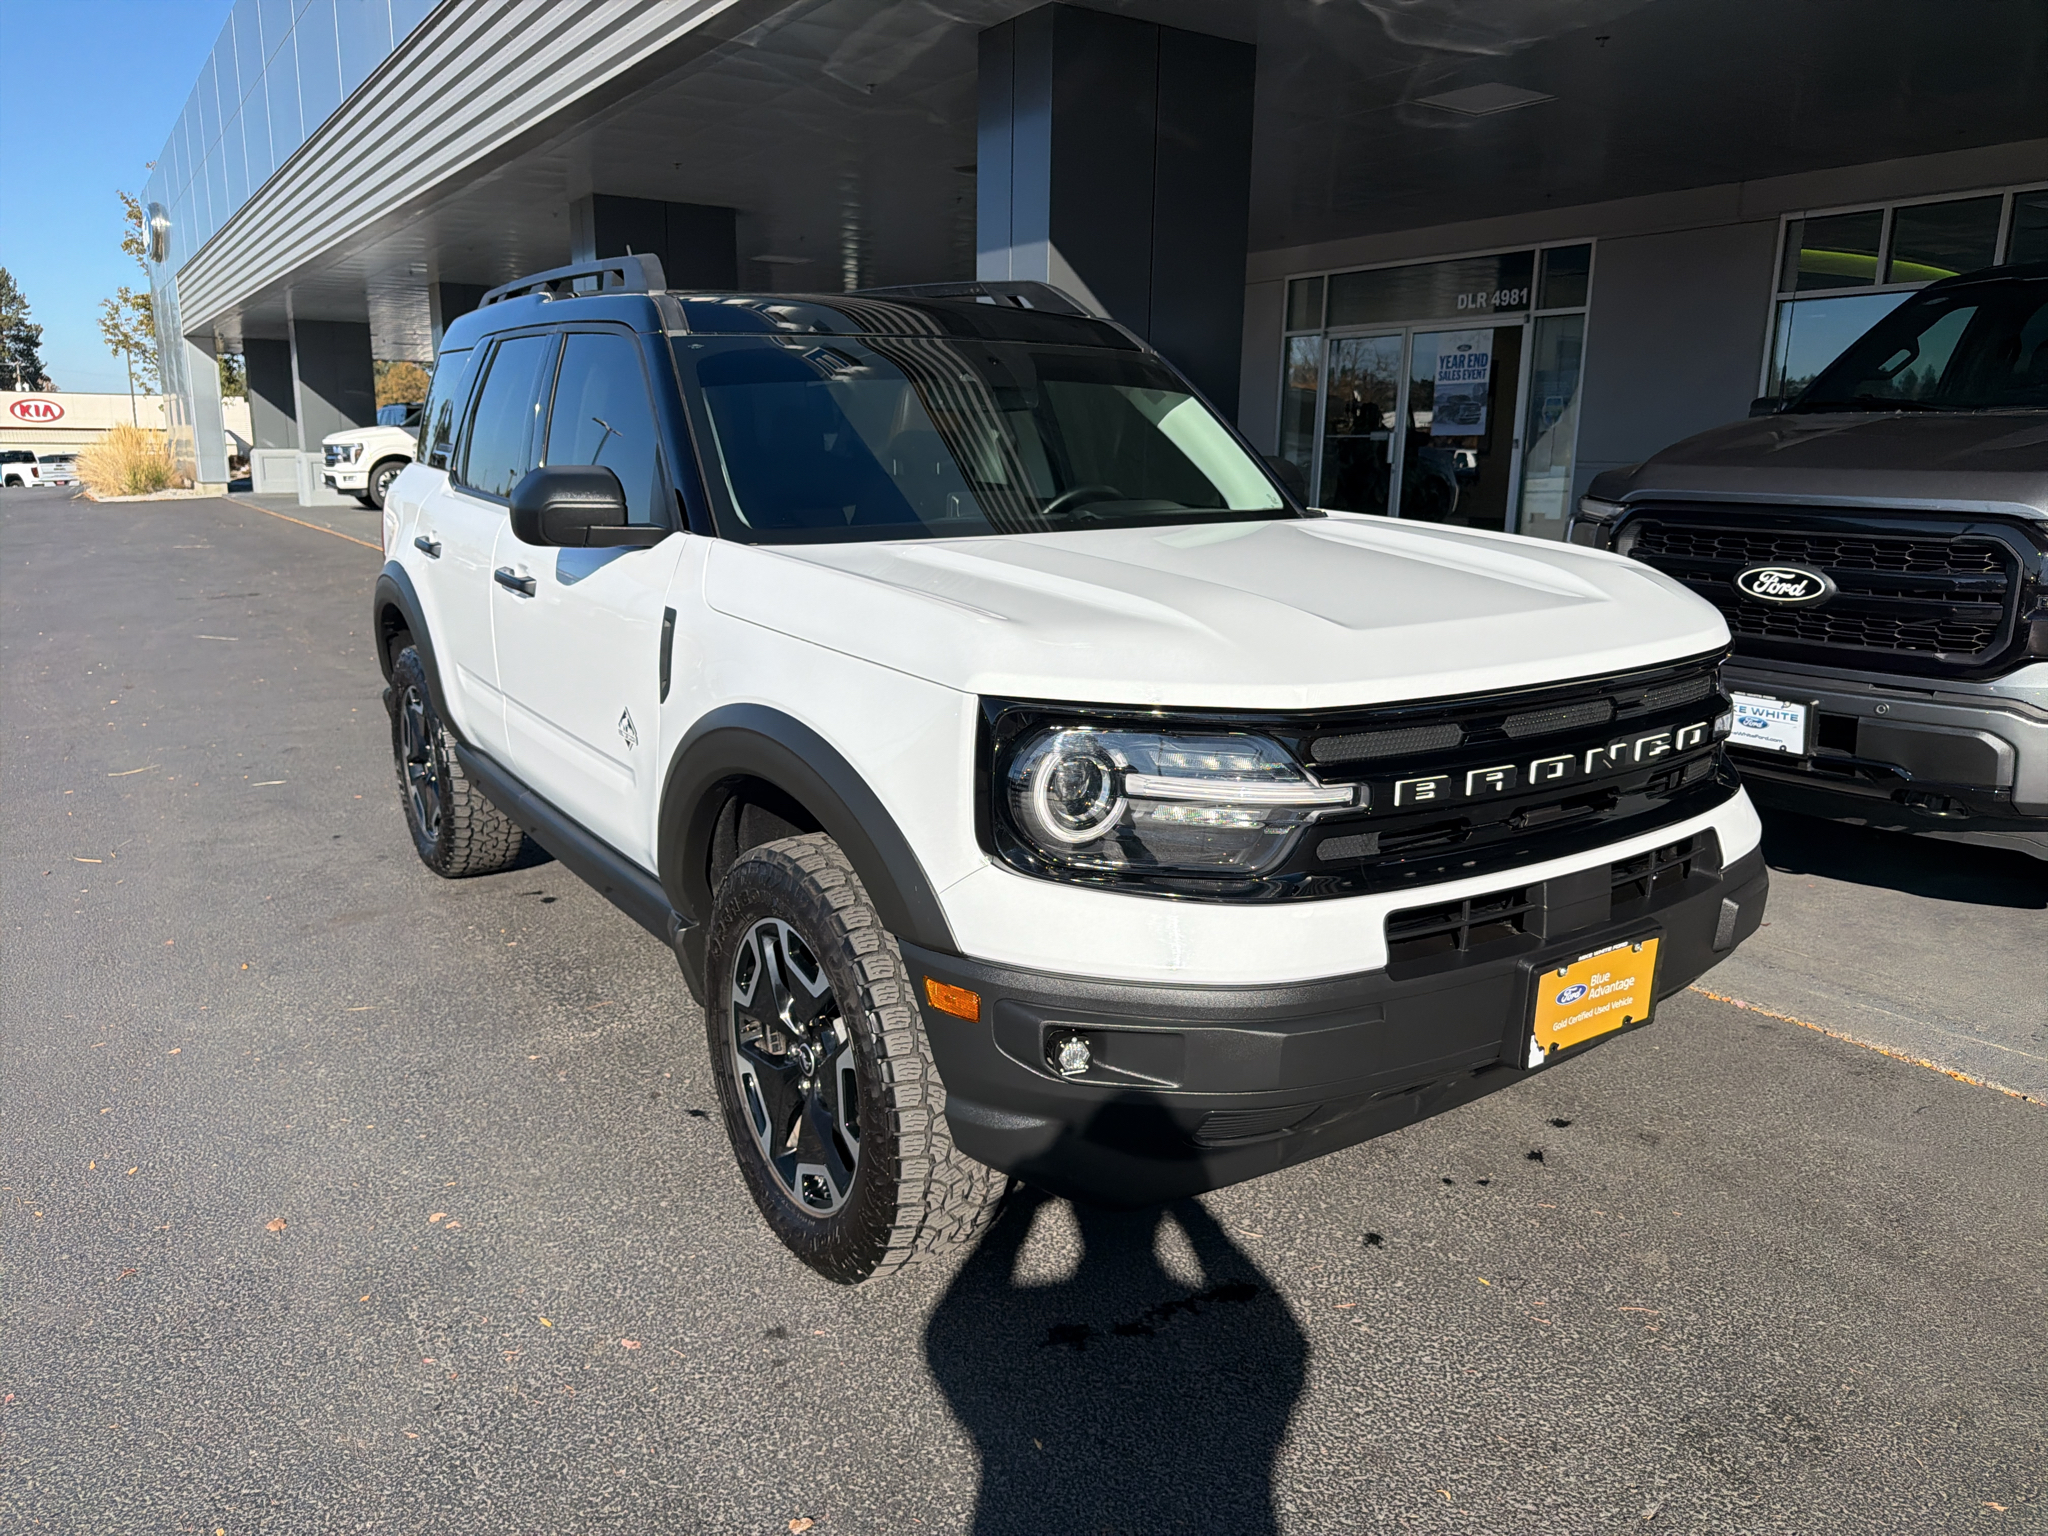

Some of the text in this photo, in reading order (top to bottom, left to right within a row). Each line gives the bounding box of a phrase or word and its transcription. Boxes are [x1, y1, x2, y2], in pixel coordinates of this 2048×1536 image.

[1457, 287, 1528, 309] DLR 4981
[1439, 353, 1489, 370] YEAR END
[1438, 368, 1487, 382] SALES EVENT
[19, 404, 57, 419] KIA
[1752, 570, 1808, 597] Ford
[1751, 706, 1799, 723] WHITE
[1394, 721, 1709, 807] BRONCO
[1588, 976, 1635, 1000] Advantage
[1590, 972, 1611, 987] Blue
[1561, 986, 1583, 1003] Ford
[1552, 996, 1633, 1031] Gold Certified Used Vehicle
